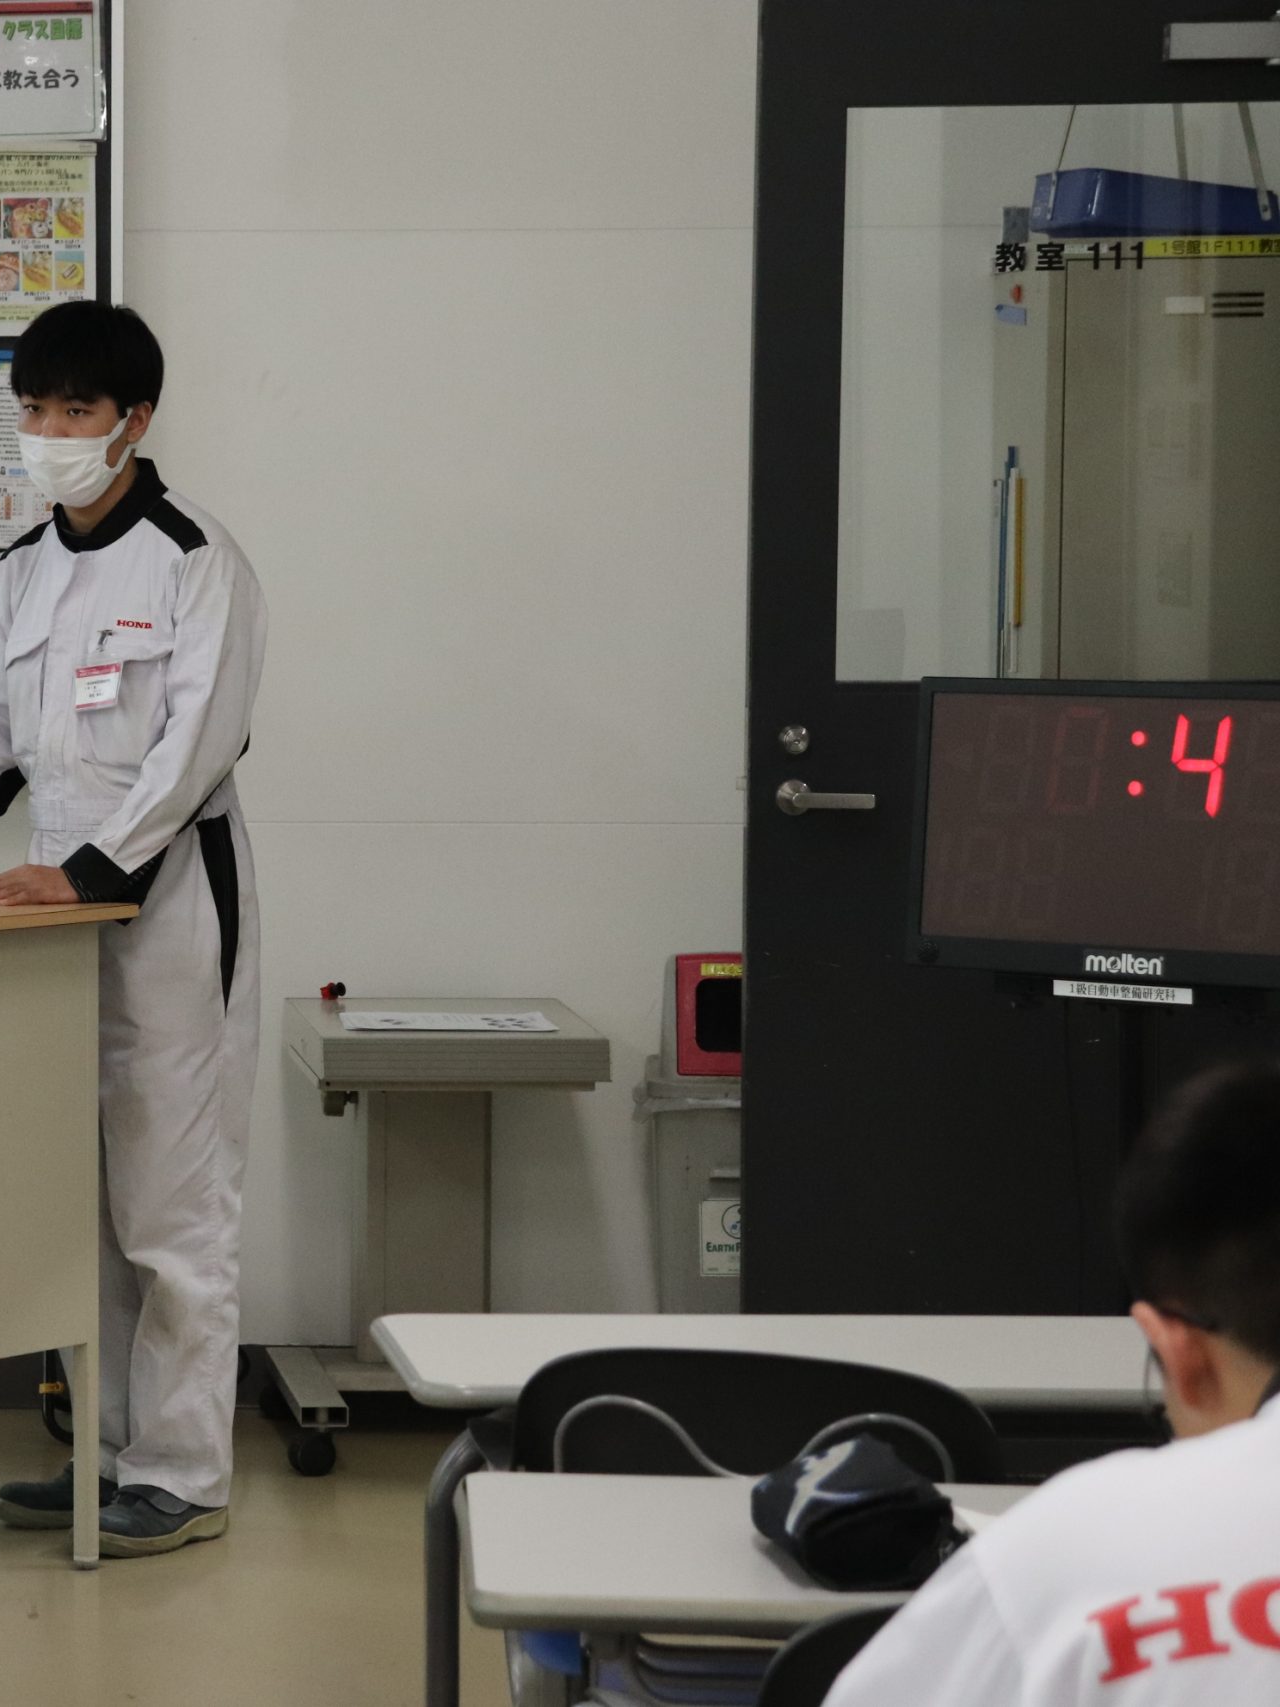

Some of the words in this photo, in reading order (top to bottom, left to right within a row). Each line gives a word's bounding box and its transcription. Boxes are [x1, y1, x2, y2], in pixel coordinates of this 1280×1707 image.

[995, 242, 1065, 272] 教室
[1087, 241, 1144, 270] 111
[1085, 953, 1164, 976] molten
[1069, 982, 1176, 1001] 1級自動車整備研究科
